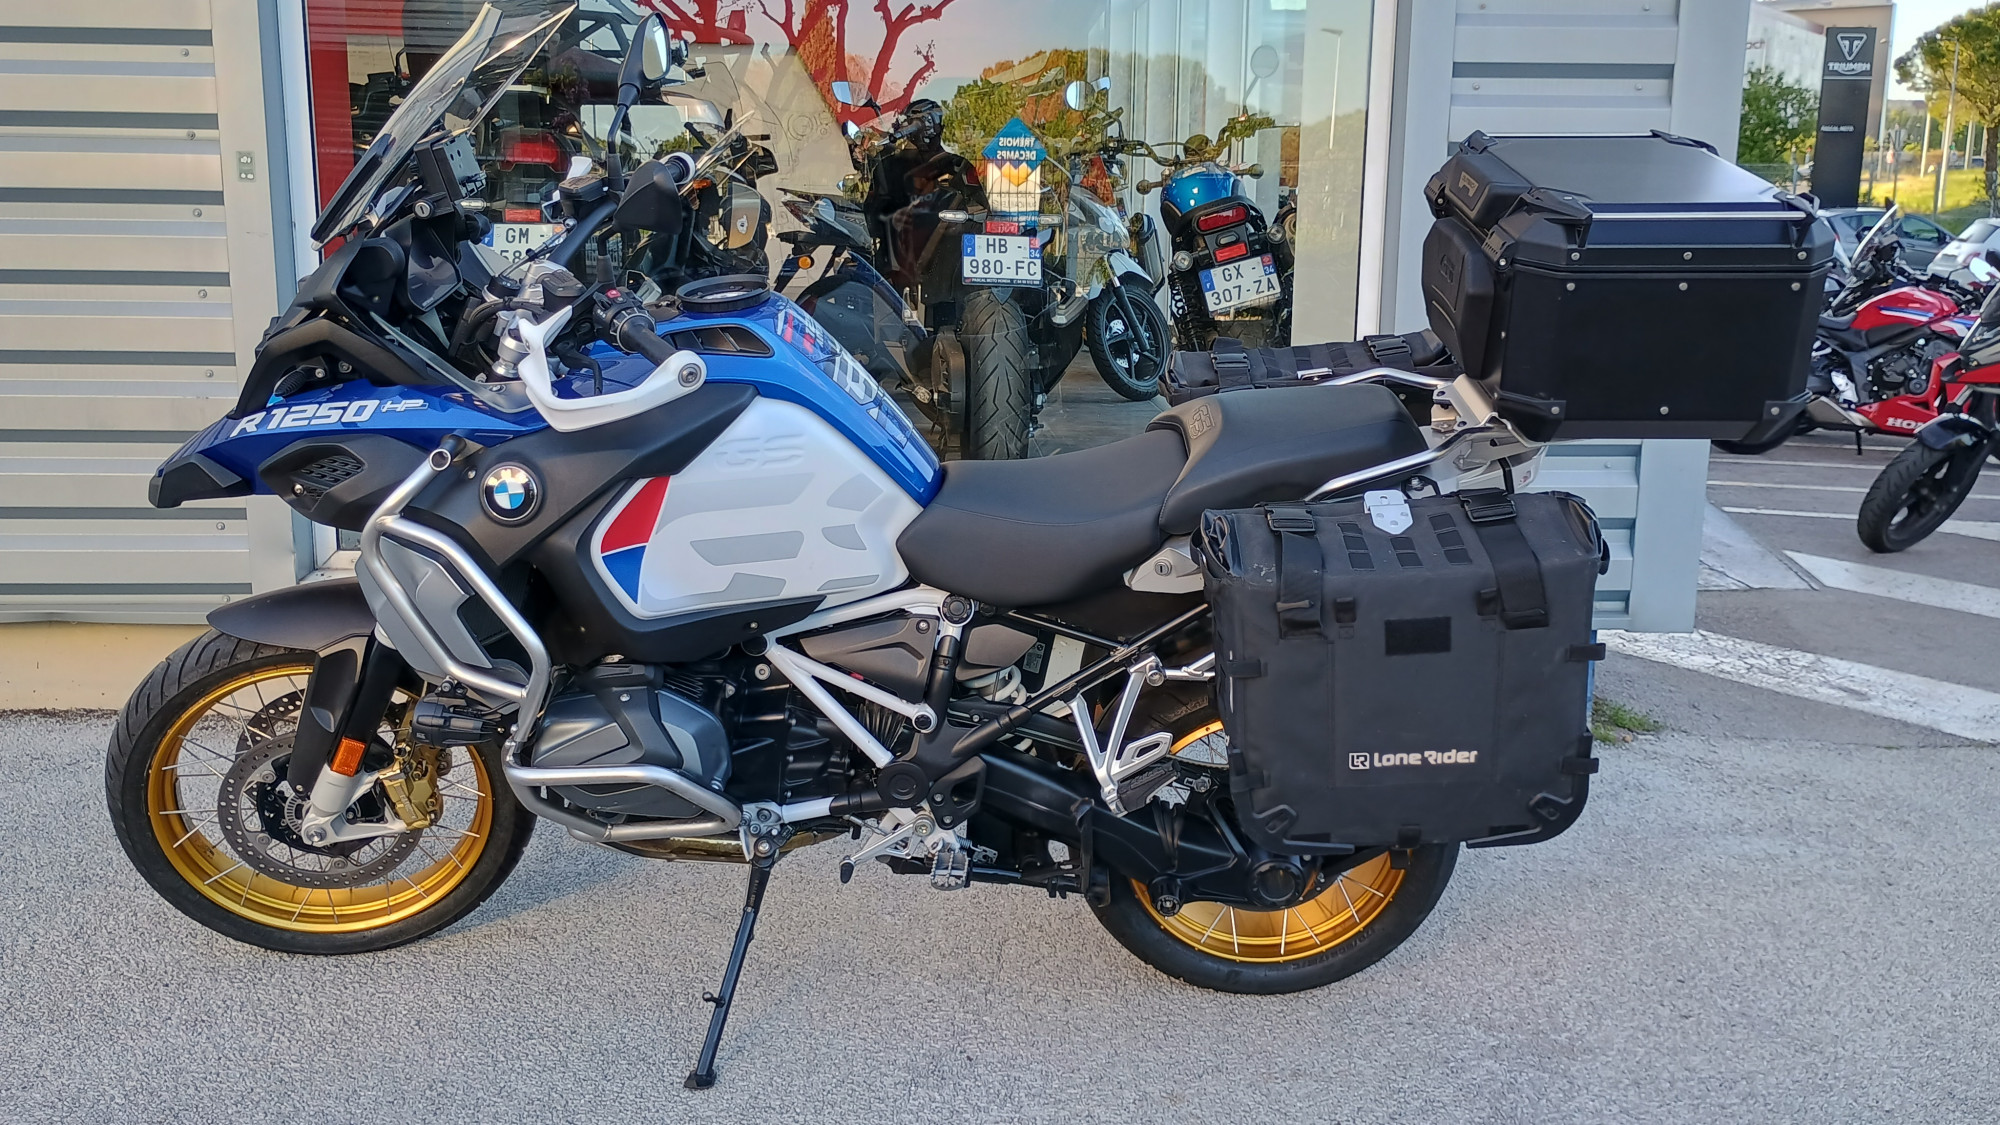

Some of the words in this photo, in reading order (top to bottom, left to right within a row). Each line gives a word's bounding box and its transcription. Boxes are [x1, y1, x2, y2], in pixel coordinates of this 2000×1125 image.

[505, 227, 530, 244] GM
[1029, 249, 1040, 258] 34
[969, 258, 1037, 277] 980-FC
[1263, 264, 1275, 275] 34
[1211, 277, 1276, 306] 307-ZA
[229, 411, 268, 438] R
[266, 399, 381, 430] 1250
[381, 399, 429, 413] HP
[1373, 752, 1422, 768] Lone
[1423, 748, 1478, 765] Rider
